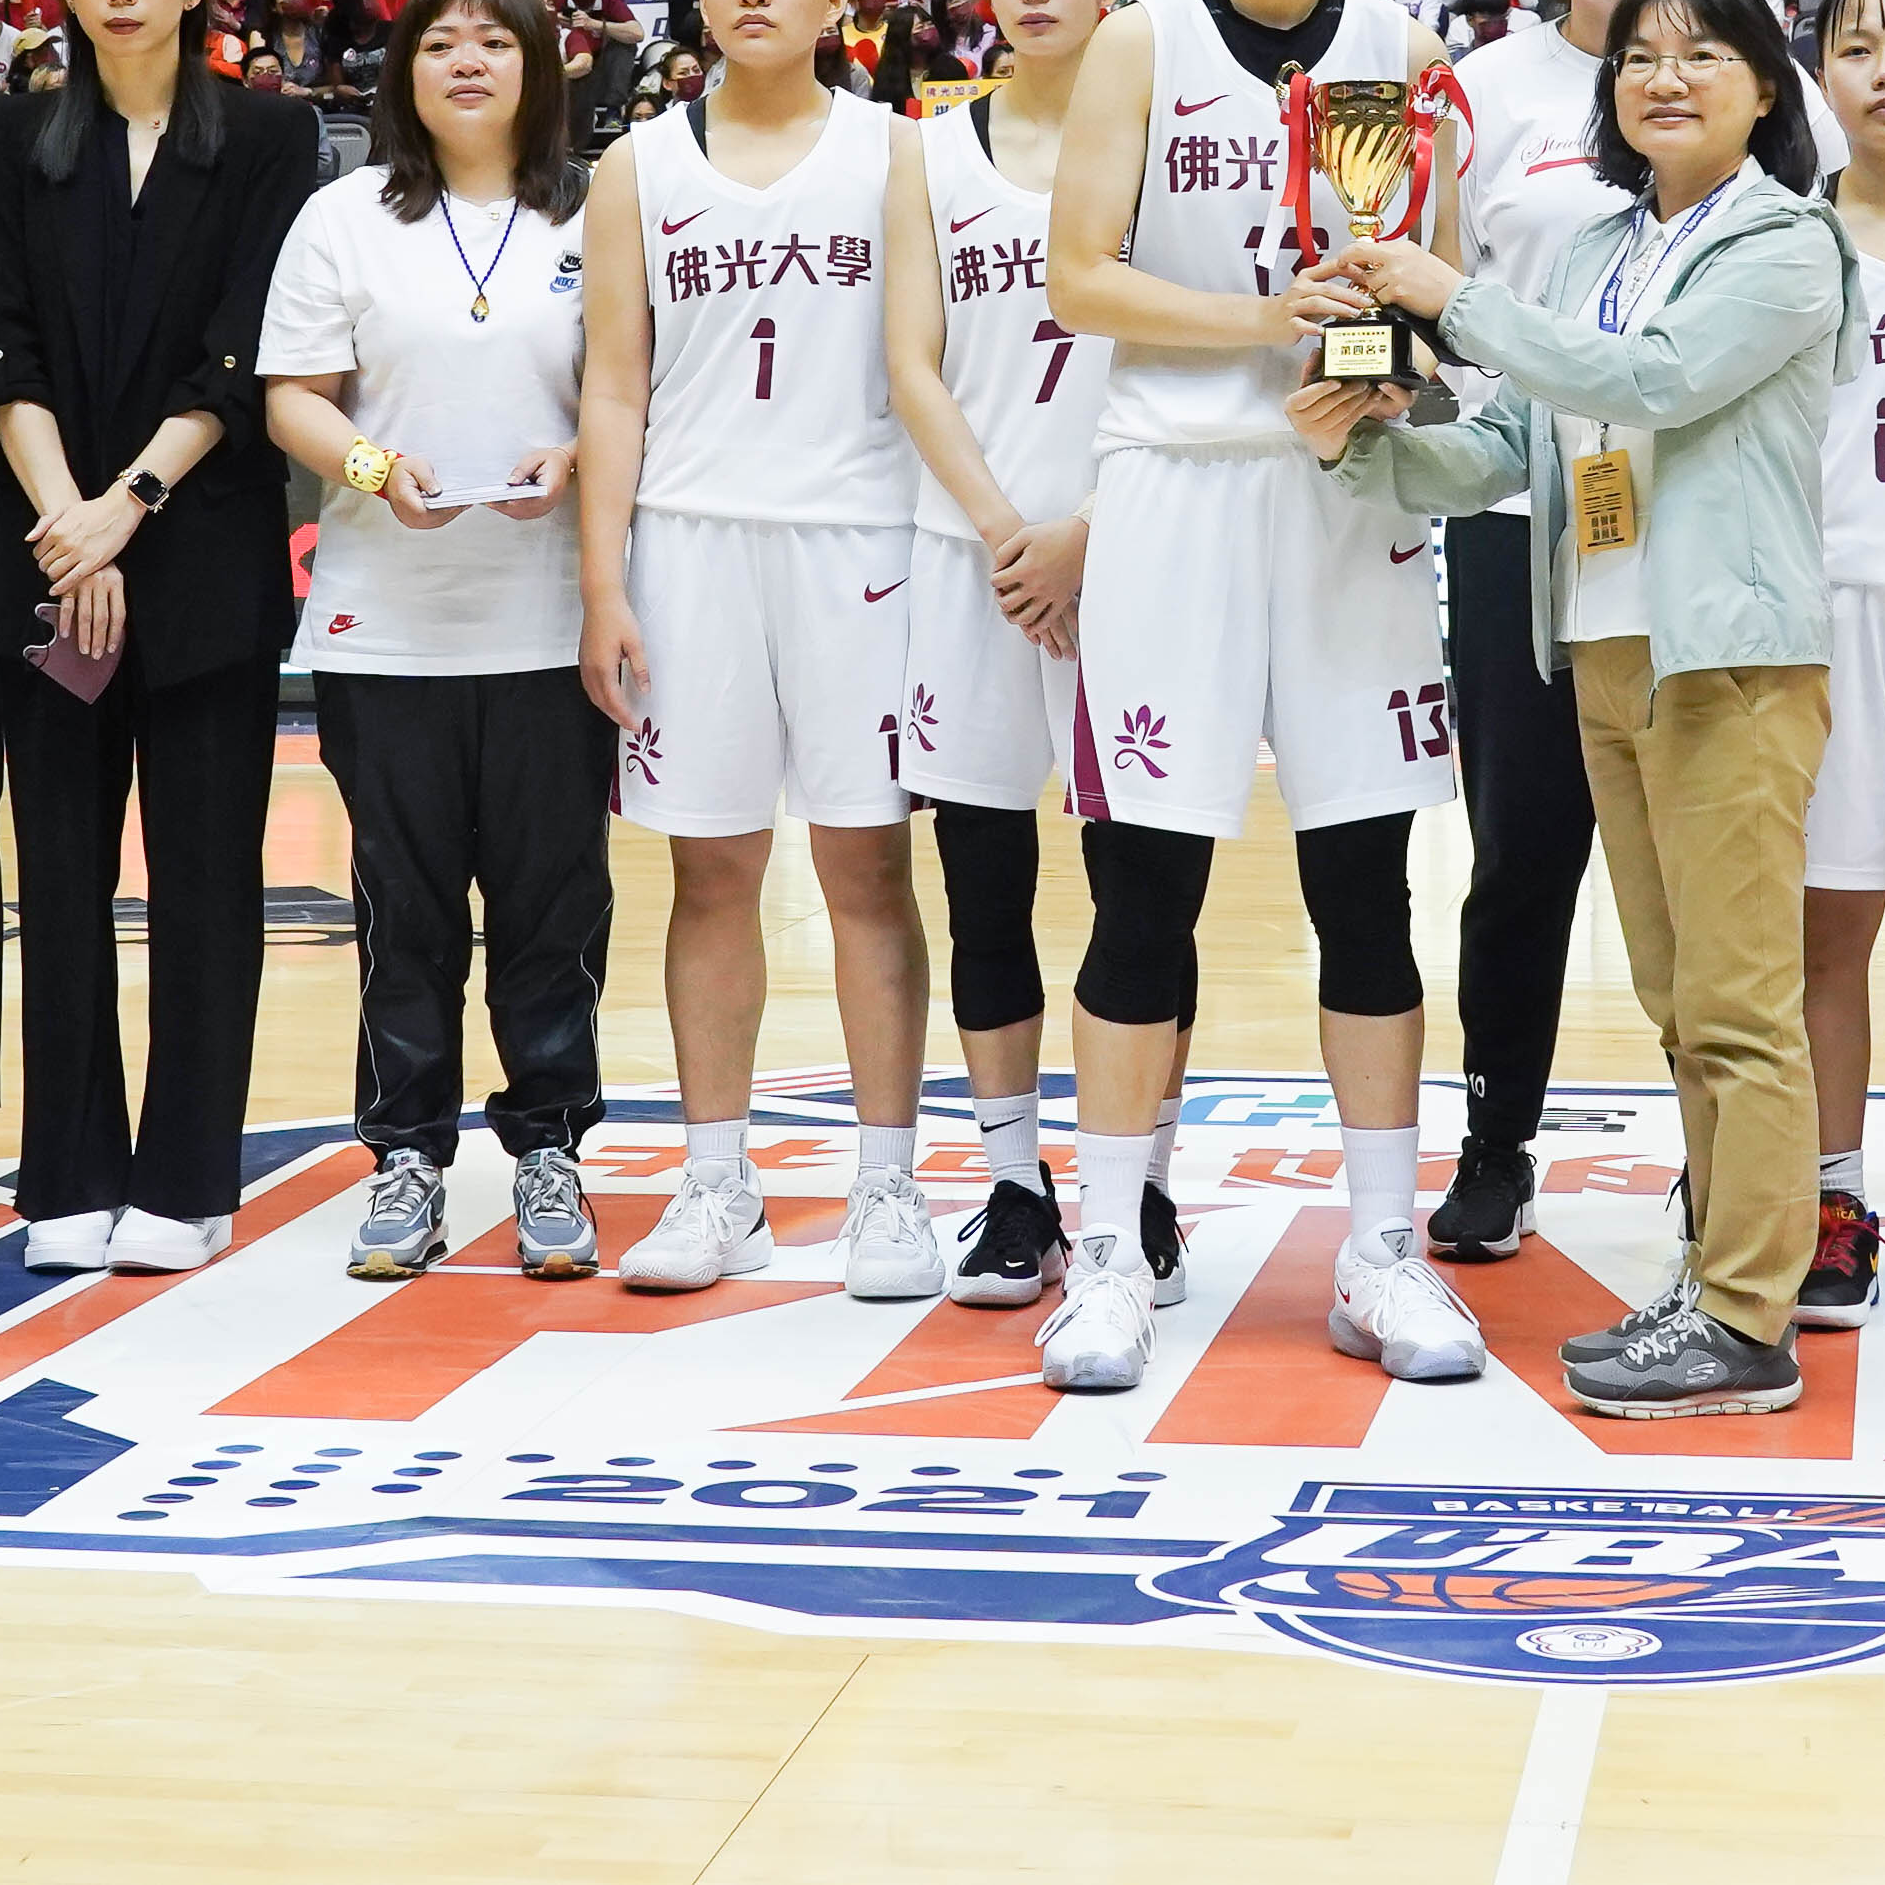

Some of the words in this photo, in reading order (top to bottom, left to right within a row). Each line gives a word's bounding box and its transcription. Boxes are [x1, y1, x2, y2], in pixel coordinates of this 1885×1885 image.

[1164, 135, 1279, 194] 佛光
[1520, 130, 1582, 165] Striv
[666, 233, 873, 303] 佛光大學
[950, 237, 1046, 304] 佛光
[750, 317, 776, 400] 1
[1033, 319, 1075, 404] 7
[1386, 682, 1451, 763] 13
[1468, 1072, 1486, 1099] 10
[501, 1474, 1152, 1518] 2021
[1432, 1499, 1809, 1521] BASKETBALL
